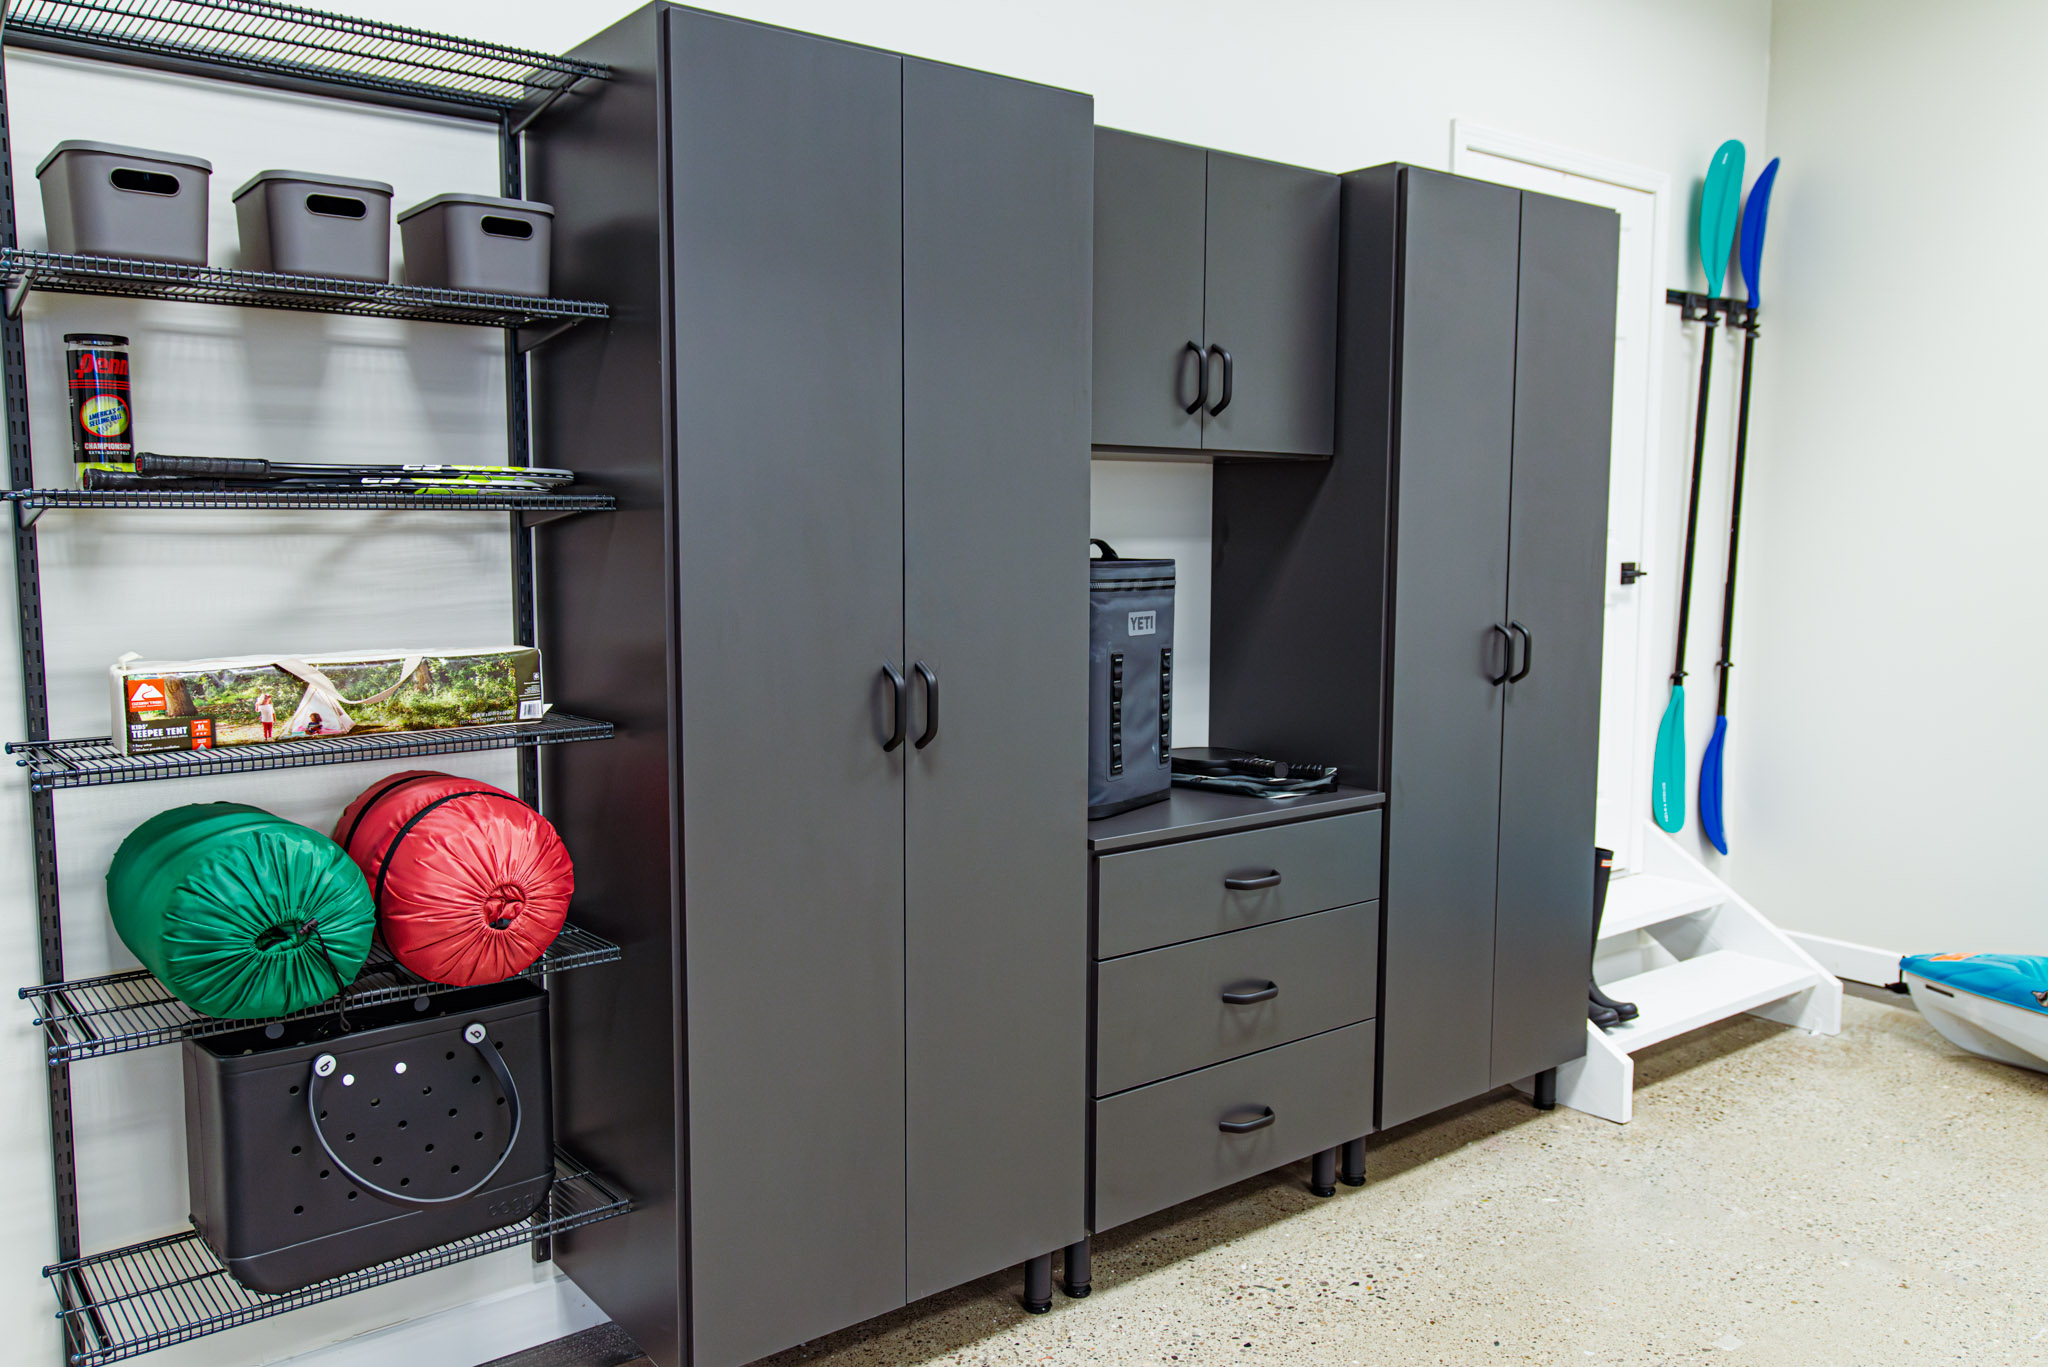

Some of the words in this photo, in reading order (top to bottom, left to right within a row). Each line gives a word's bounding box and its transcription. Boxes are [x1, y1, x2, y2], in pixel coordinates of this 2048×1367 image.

[74, 353, 128, 379] Penn
[89, 408, 117, 420] AMERICA'S
[89, 416, 110, 427] SELLING
[110, 413, 123, 422] BALL
[84, 442, 132, 450] CHAMPIONSHIP
[1130, 616, 1153, 631] YETI
[131, 729, 164, 739] TEEPEE
[166, 727, 188, 736] TENT
